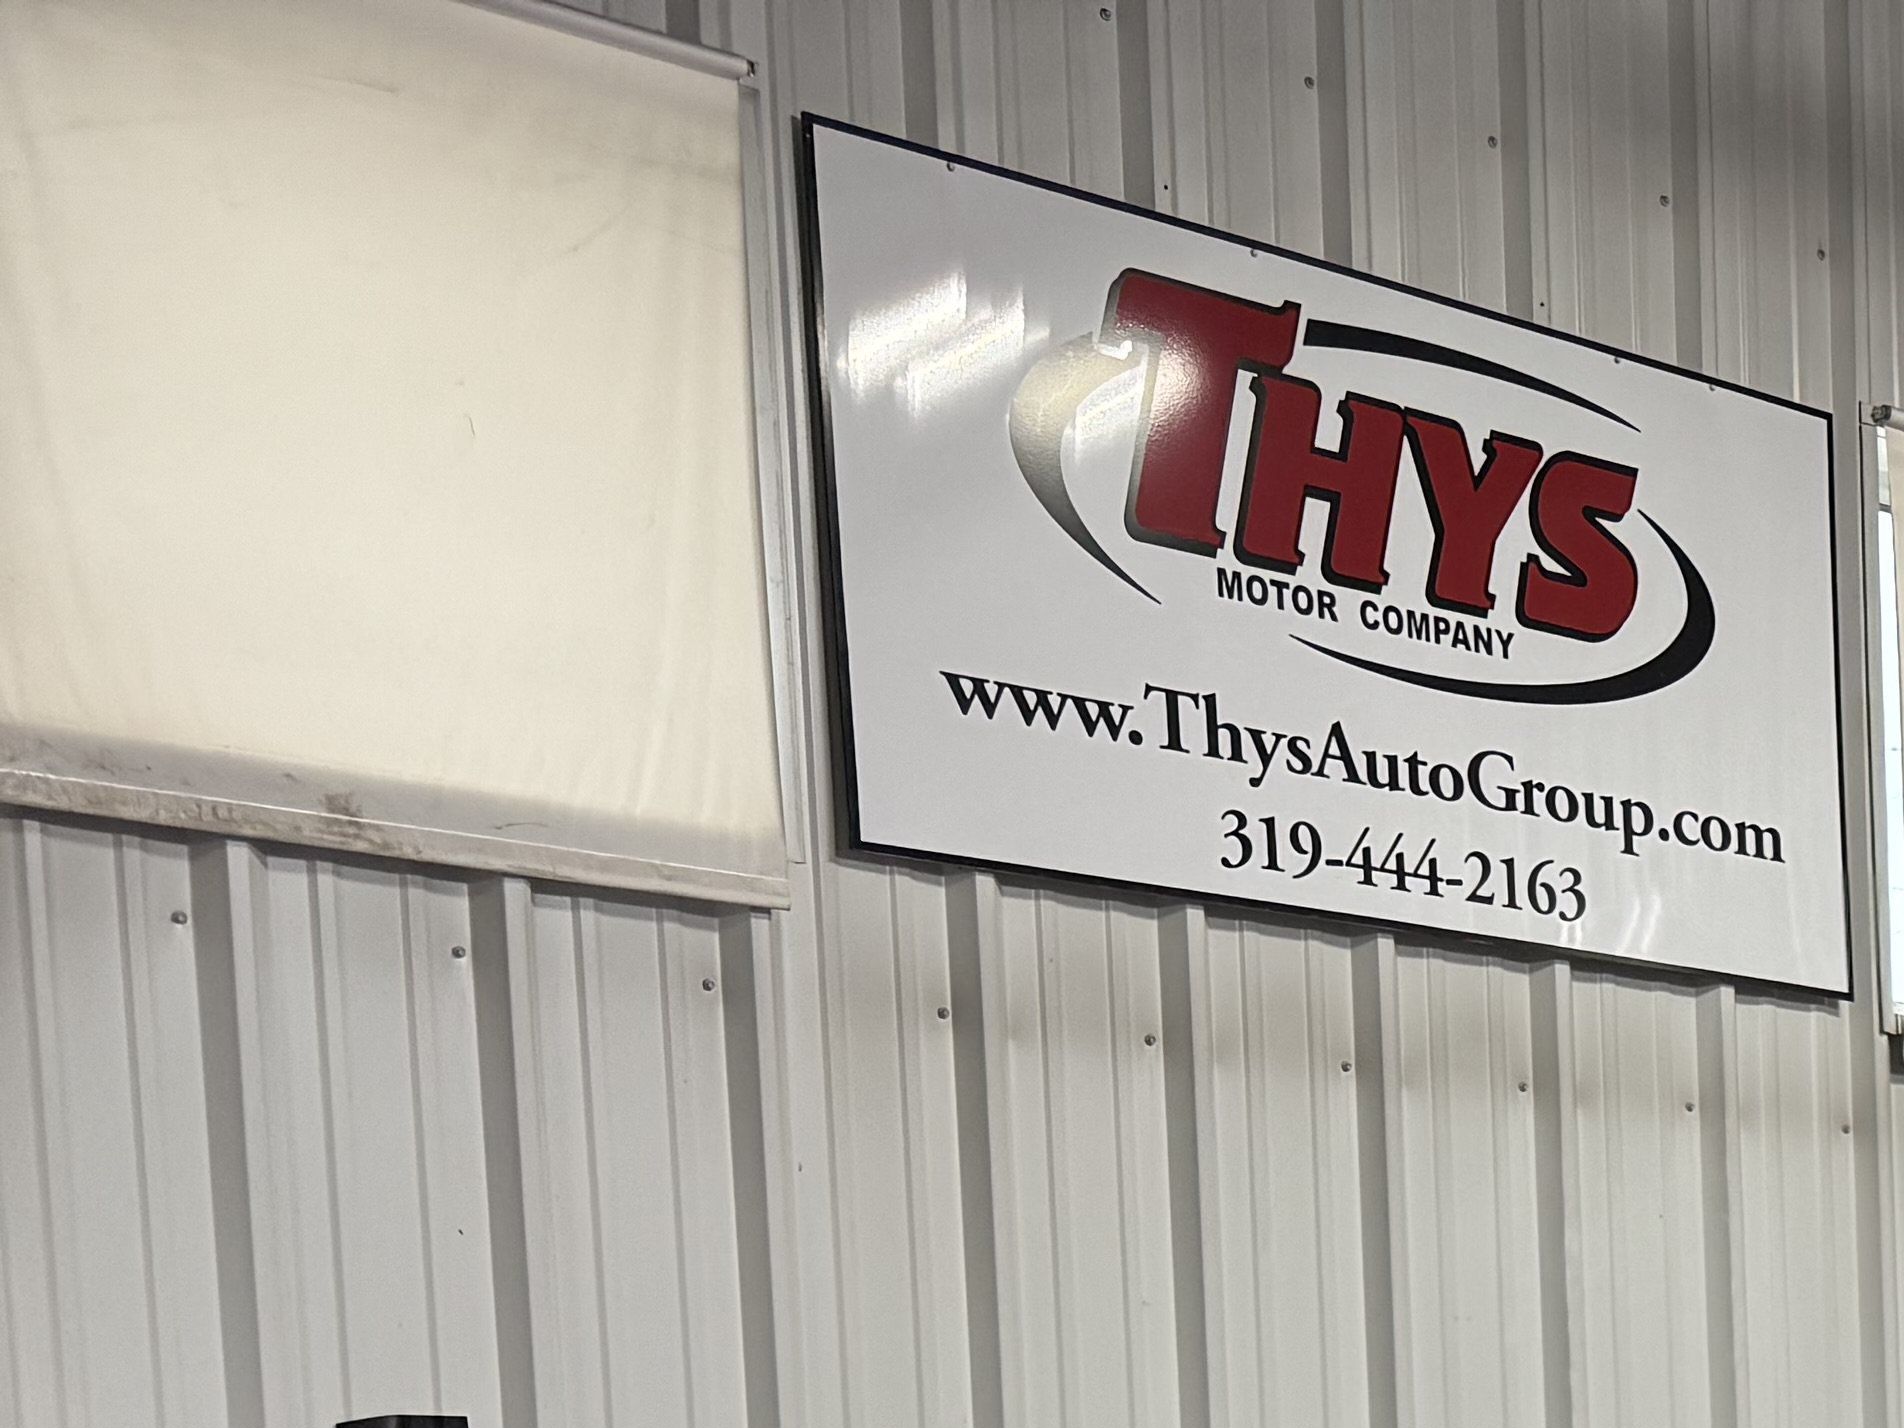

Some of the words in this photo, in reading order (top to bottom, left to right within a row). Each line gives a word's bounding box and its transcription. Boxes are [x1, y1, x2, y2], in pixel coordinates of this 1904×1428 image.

[1100, 266, 1640, 643] THYS
[1215, 567, 1339, 624] MOTOR
[1358, 599, 1515, 660] COMPANY
[939, 667, 1786, 864] www.ThysAutoGroup.com
[1219, 809, 1589, 923] 319-444-2163
